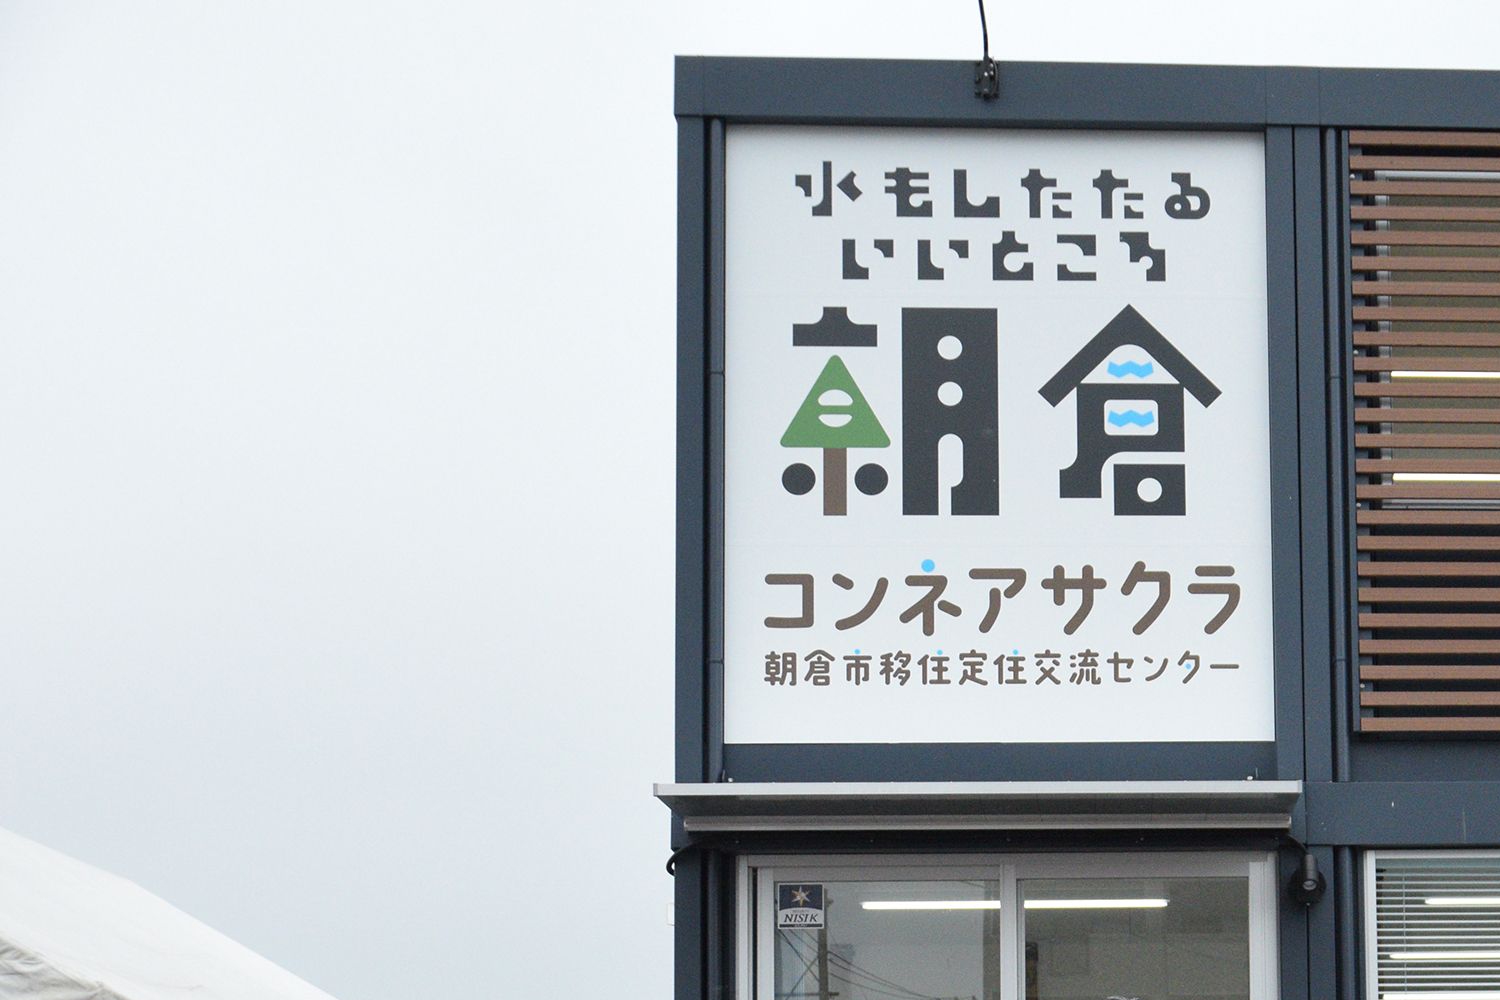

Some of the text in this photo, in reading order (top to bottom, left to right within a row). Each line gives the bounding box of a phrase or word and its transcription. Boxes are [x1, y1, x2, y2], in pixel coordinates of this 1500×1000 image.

[795, 161, 1211, 219] 水もしたたる
[842, 231, 1166, 282] いいところ
[780, 304, 1223, 516] 朝倉
[764, 560, 1241, 636] コンネアサクラ
[764, 649, 1240, 687] 朝倉市移住定住交流センター
